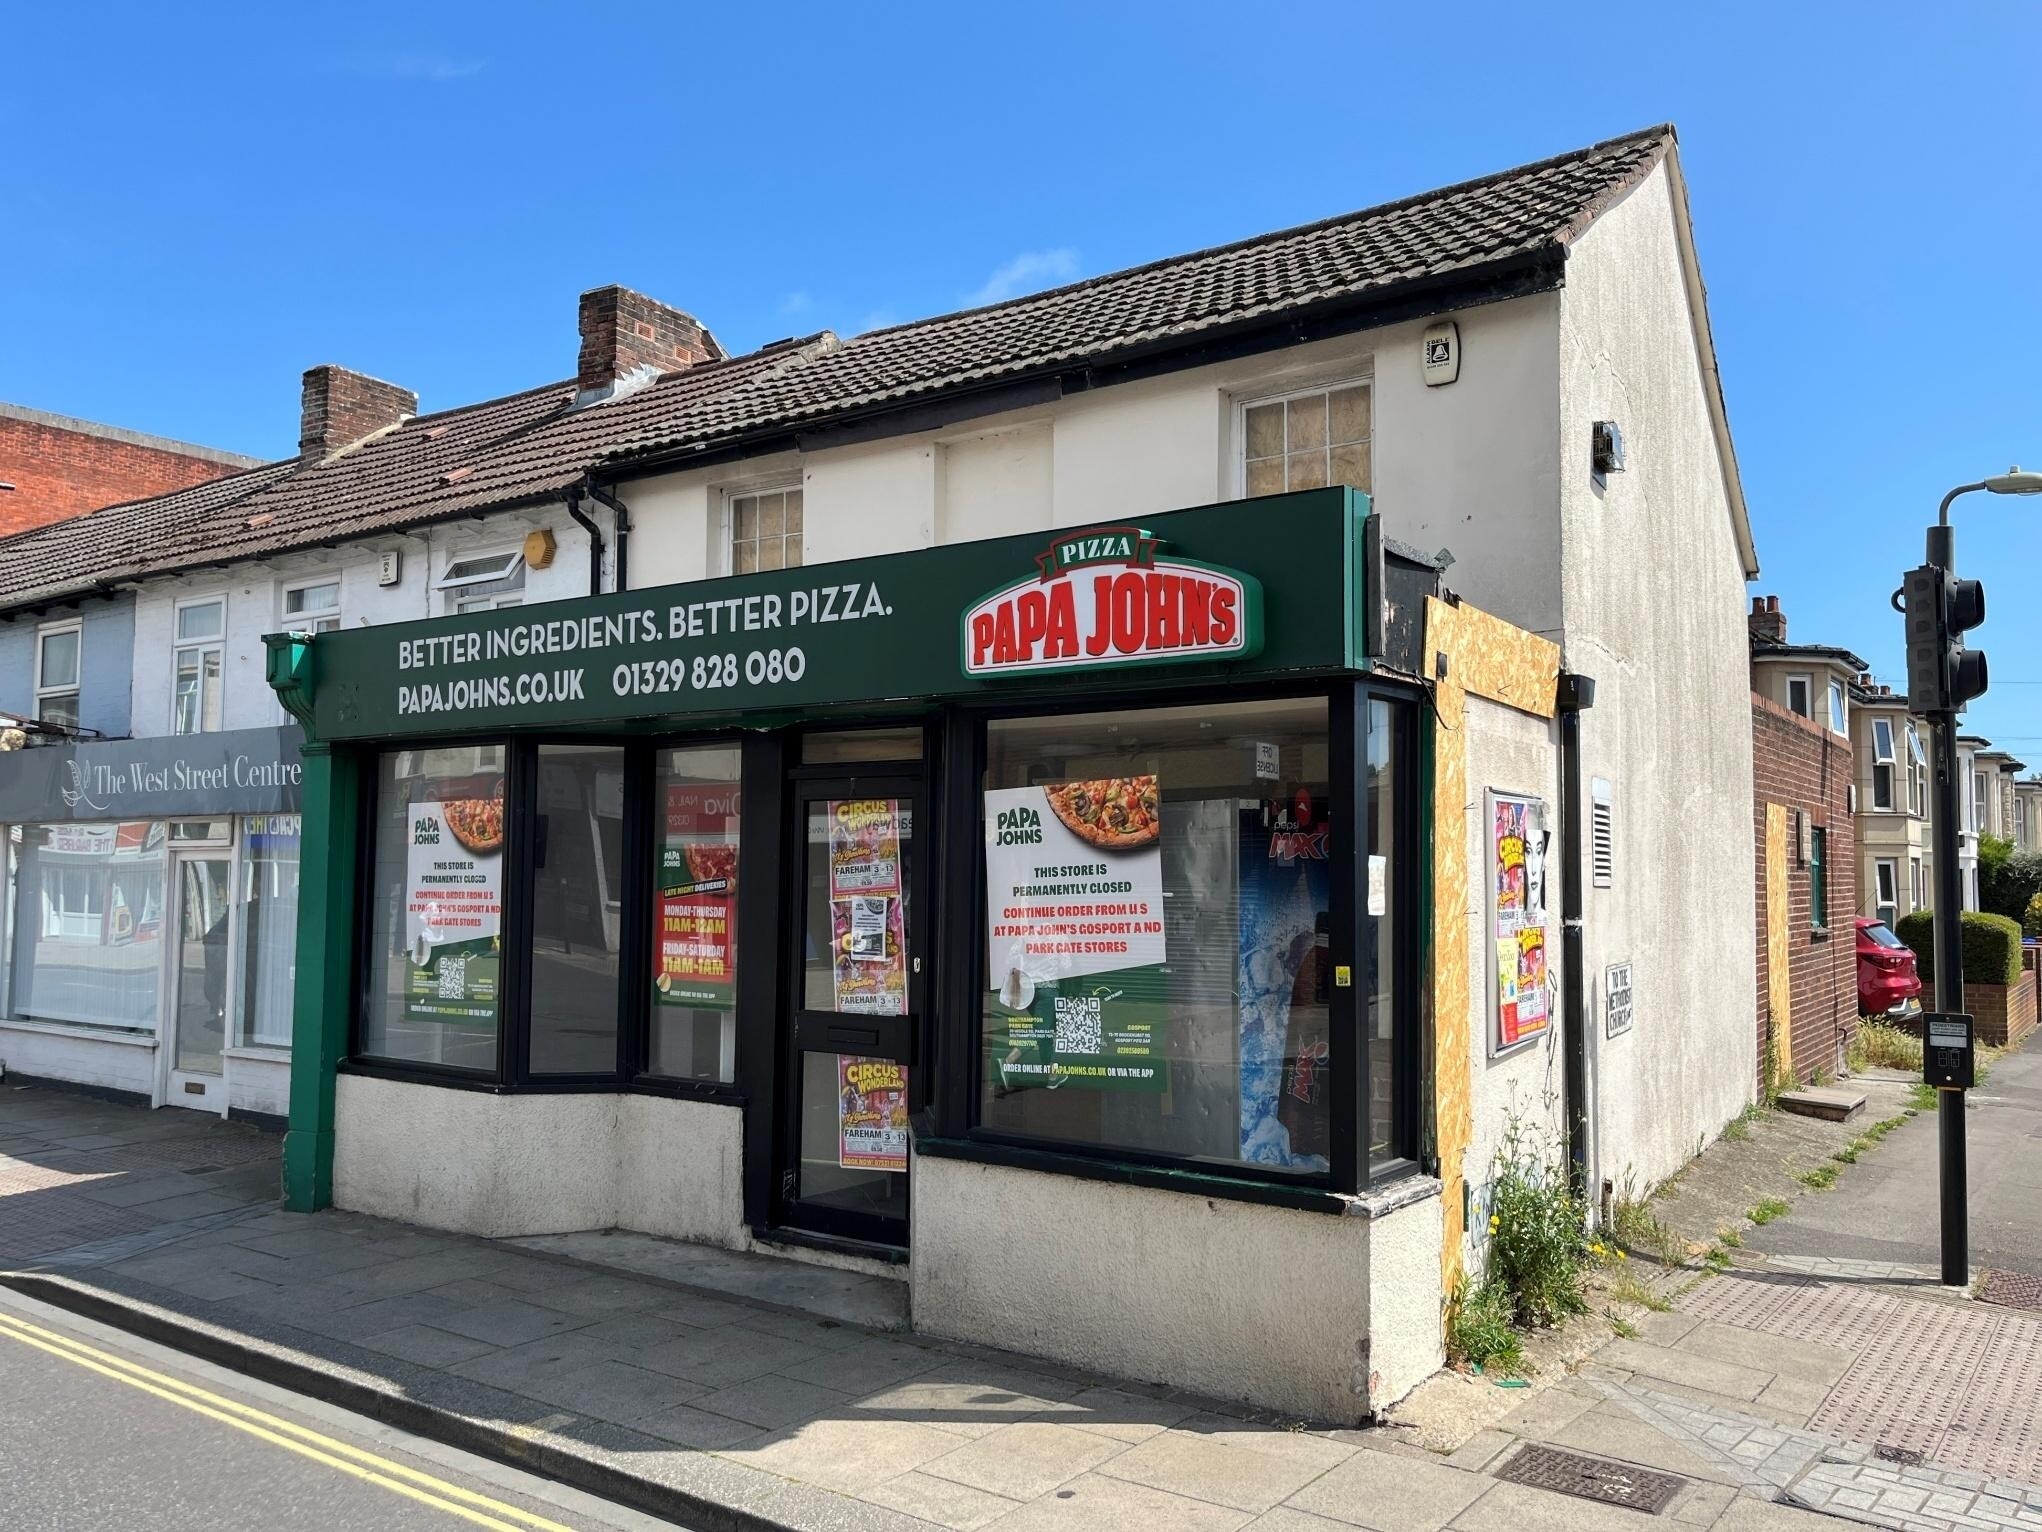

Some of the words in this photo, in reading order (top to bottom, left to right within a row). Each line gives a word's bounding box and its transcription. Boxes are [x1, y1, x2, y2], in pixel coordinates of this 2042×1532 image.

[1061, 536, 1132, 564] PIZZA
[399, 632, 481, 670] BETTER
[486, 609, 663, 660] INGREDIENTS.
[669, 594, 782, 639] BETTER
[790, 581, 893, 626] PIZZA.
[972, 581, 1080, 667] PAPA
[1086, 571, 1237, 657] JOHN'S
[398, 668, 585, 715] PAPAJOHNS.CO.UK
[612, 658, 685, 697] 01329
[691, 653, 739, 690] 828
[745, 646, 806, 685] 080
[94, 765, 126, 795] The
[130, 762, 170, 793] West
[174, 759, 230, 791] Street
[234, 755, 302, 788] Centre
[837, 801, 888, 822] CIRCUS
[997, 807, 1041, 830] PAPA
[414, 816, 440, 834] PAPA
[847, 812, 893, 831] WONDERLAND
[414, 833, 440, 846] JOHNS
[996, 829, 1043, 846] JOHNS
[1268, 832, 1323, 861] MAX
[663, 851, 680, 860] PAPA
[434, 861, 448, 870] THIS
[448, 861, 467, 870] STORE
[468, 861, 474, 870] IS
[835, 864, 871, 875] FAREHAM
[886, 864, 894, 872] 13
[1034, 866, 1059, 878] THIS
[1060, 864, 1094, 877] STORE
[1096, 863, 1107, 875] IS
[421, 875, 463, 884] PERMANENTLY
[464, 875, 487, 883] CLOSED
[415, 891, 446, 899] CONTINUE
[446, 891, 466, 899] ORDER
[466, 891, 483, 899] FROM
[664, 888, 677, 897] LATE
[677, 885, 694, 895] NIGHT
[694, 880, 726, 892] DELIVERIES
[1012, 883, 1088, 897] PERMANENTLY
[1089, 881, 1132, 894] CLOSED
[409, 904, 417, 912] AT
[457, 905, 485, 913] GOSPORT
[664, 905, 727, 918] MONDAY-THURSDAY
[1003, 906, 1055, 919] CONTINUE
[1057, 905, 1093, 917] ORDER
[1095, 904, 1127, 916] FROM
[444, 918, 459, 926] GATE
[459, 918, 482, 927] STORES
[994, 925, 1006, 936] AT
[1008, 924, 1035, 936] PAPA
[1037, 923, 1077, 936] JOHN'S
[1079, 922, 1132, 934] GOSPORT
[663, 942, 726, 957] FRIDAY-SATURDAY
[1025, 942, 1054, 954] PARK
[1056, 942, 1084, 953] GATE
[1084, 941, 1127, 953] STORES
[1612, 971, 1618, 989] TO
[1619, 968, 1628, 987] THE
[840, 995, 877, 1005] FAREHAM
[847, 1063, 899, 1083] CIRCUS
[1003, 1063, 1021, 1073] ORDER
[1022, 1064, 1042, 1074] ONLINE
[1043, 1064, 1050, 1074] AT
[1051, 1065, 1107, 1076] PAPAJOHNS.CO.UK
[1107, 1067, 1117, 1076] OR
[1117, 1067, 1128, 1077] VIA
[1128, 1068, 1140, 1077] THE
[1141, 1068, 1154, 1078] APP
[857, 1077, 905, 1095] WONDERLAND
[845, 1129, 882, 1139] FAREHAM
[898, 1133, 906, 1141] 13
